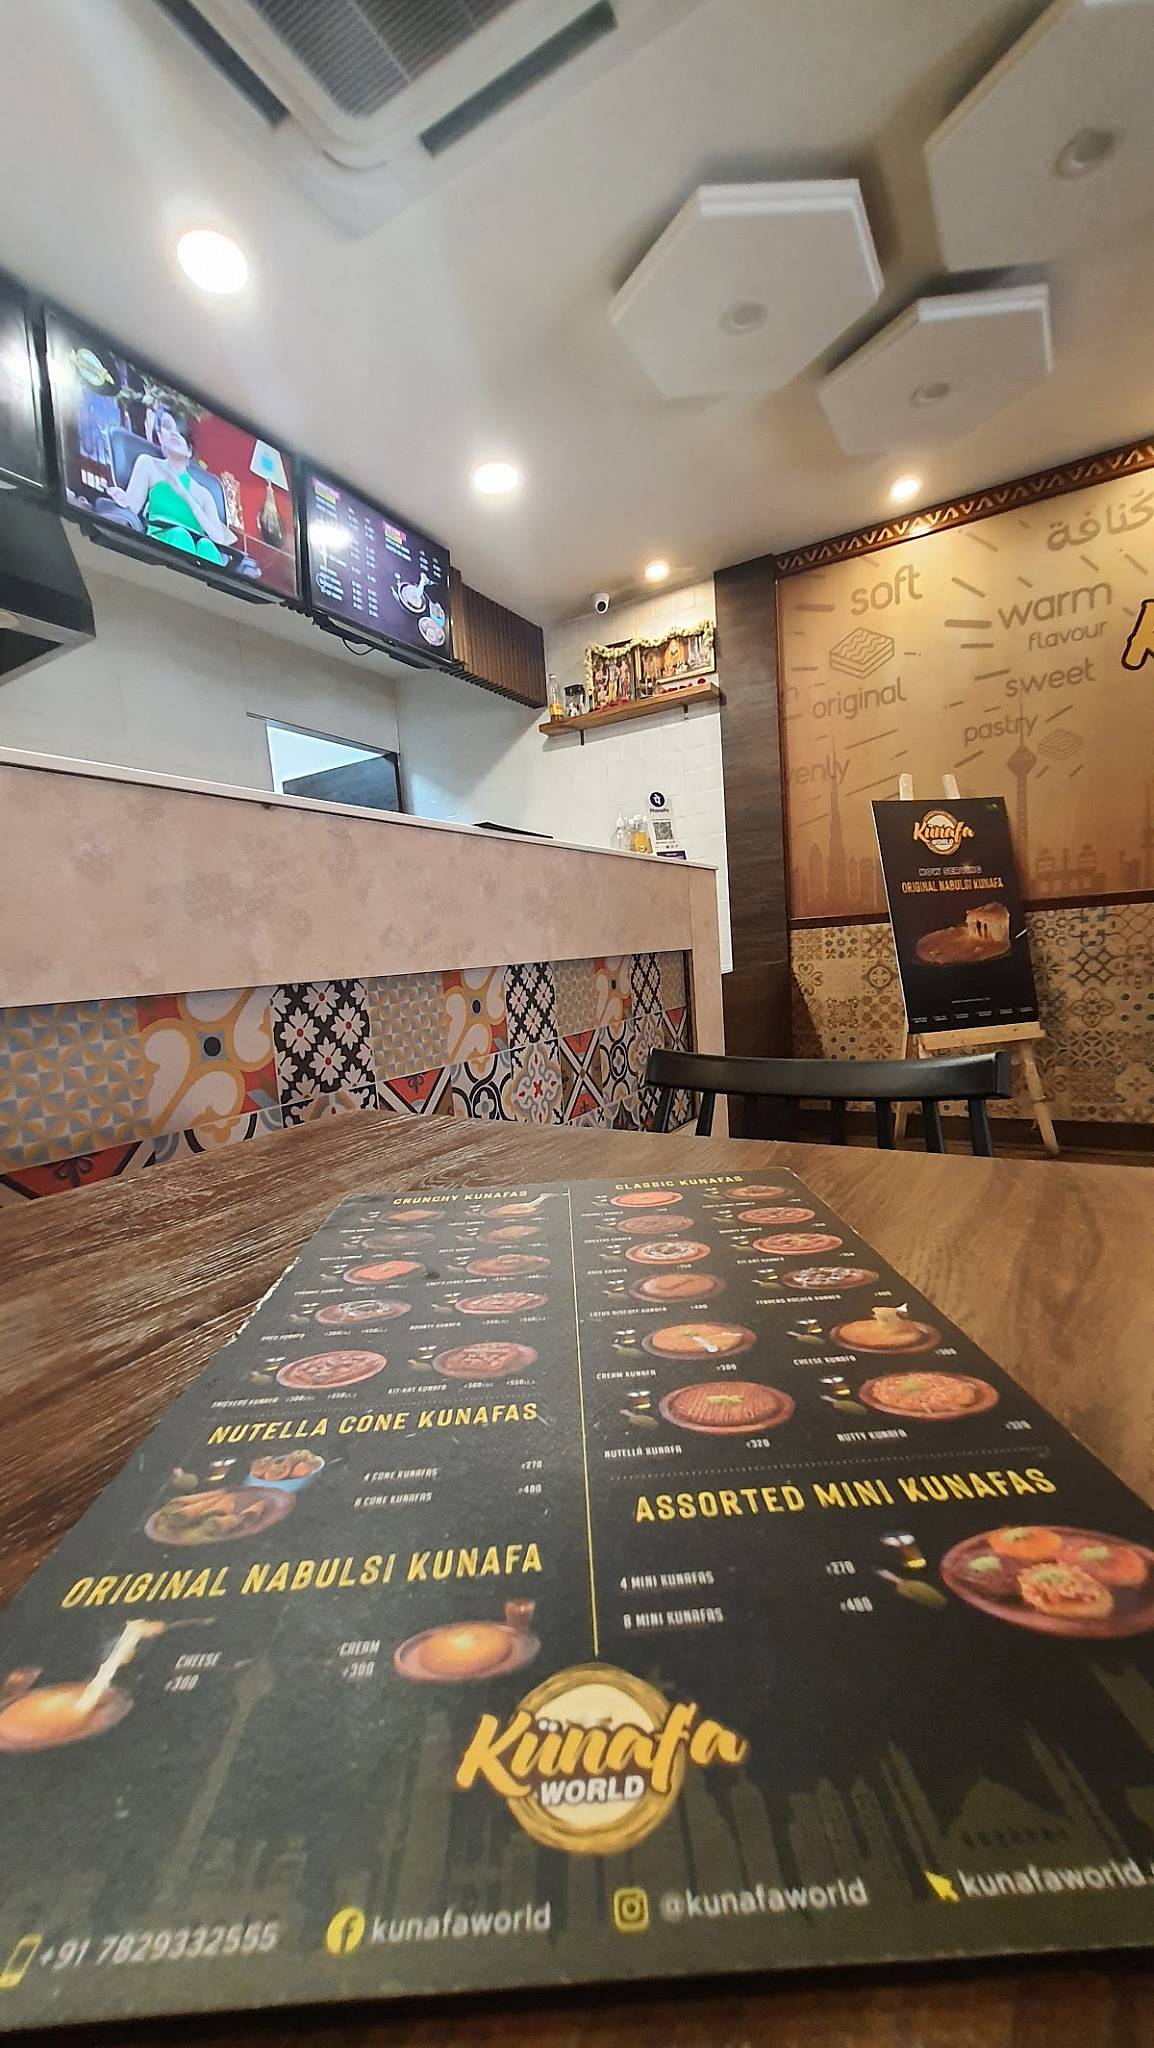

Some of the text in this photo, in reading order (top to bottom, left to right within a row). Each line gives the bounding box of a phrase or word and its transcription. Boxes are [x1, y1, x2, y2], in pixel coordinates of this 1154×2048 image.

[850, 564, 923, 615] soft
[997, 582, 1112, 629] warm
[1028, 621, 1108, 651] flavour
[1005, 657, 1096, 697] sweet
[812, 676, 907, 719] original
[964, 715, 1037, 748] pastry
[901, 877, 1004, 894] ORIGINAL NABULSI KUNAFA
[393, 1190, 529, 1206] CRUNCHY KUNAFAS
[615, 1175, 744, 1191] CLASSIC KUNAFAS
[208, 1402, 538, 1445] NUTELLA CONE KUNAFAS
[635, 1468, 1057, 1523] ASSORTED MINI KUNAFAS
[61, 1543, 543, 1609] ORIGINAL NABULSI KUNAFA
[620, 1571, 714, 1591] 4 MINI KUNAFAS
[636, 1612, 664, 1628] MINI
[666, 1607, 724, 1625] KUNAFAS
[175, 1652, 222, 1670] CHEESE
[339, 1640, 381, 1657] CREAM
[540, 1775, 645, 1806] WORLD
[957, 1857, 1154, 1898] kunafaworld.
[661, 1877, 869, 1921] @kunafaworld
[371, 1902, 551, 1944] kunafaworld
[40, 1920, 281, 1972] +91 7829332555
